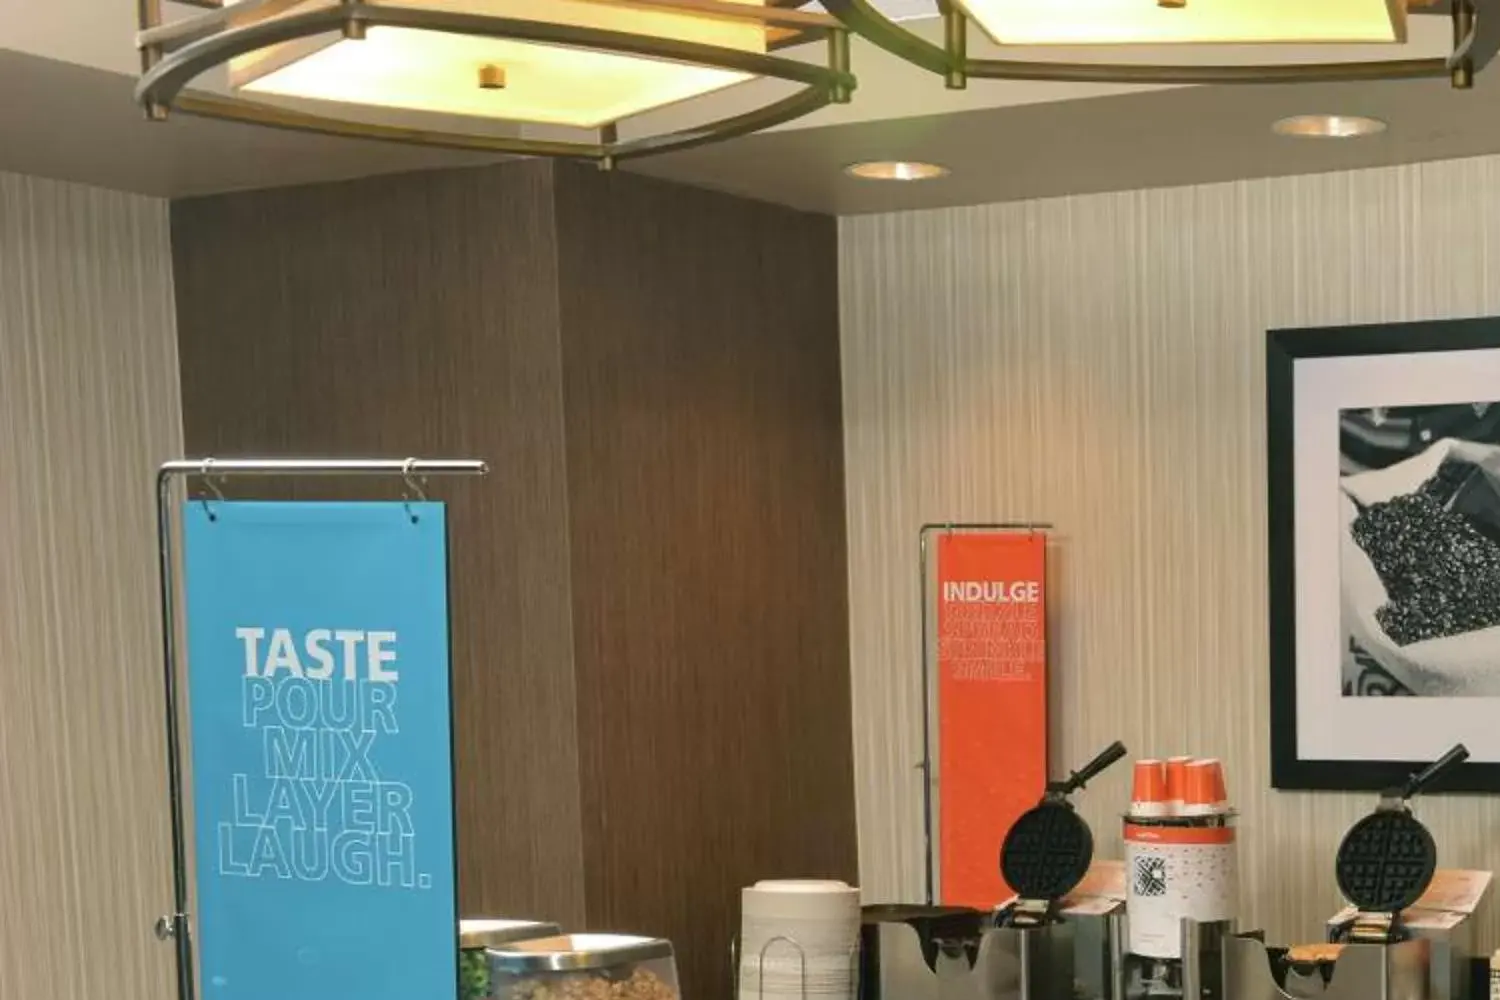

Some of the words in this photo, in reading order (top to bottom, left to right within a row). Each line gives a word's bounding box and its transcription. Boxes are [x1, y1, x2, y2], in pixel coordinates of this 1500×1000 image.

[944, 581, 1039, 603] INDULGE
[236, 627, 399, 681] TASTE
[243, 675, 398, 733] POUR
[263, 726, 377, 781] MIX
[234, 774, 414, 835] LAYER
[219, 822, 431, 888] LAUGH.
